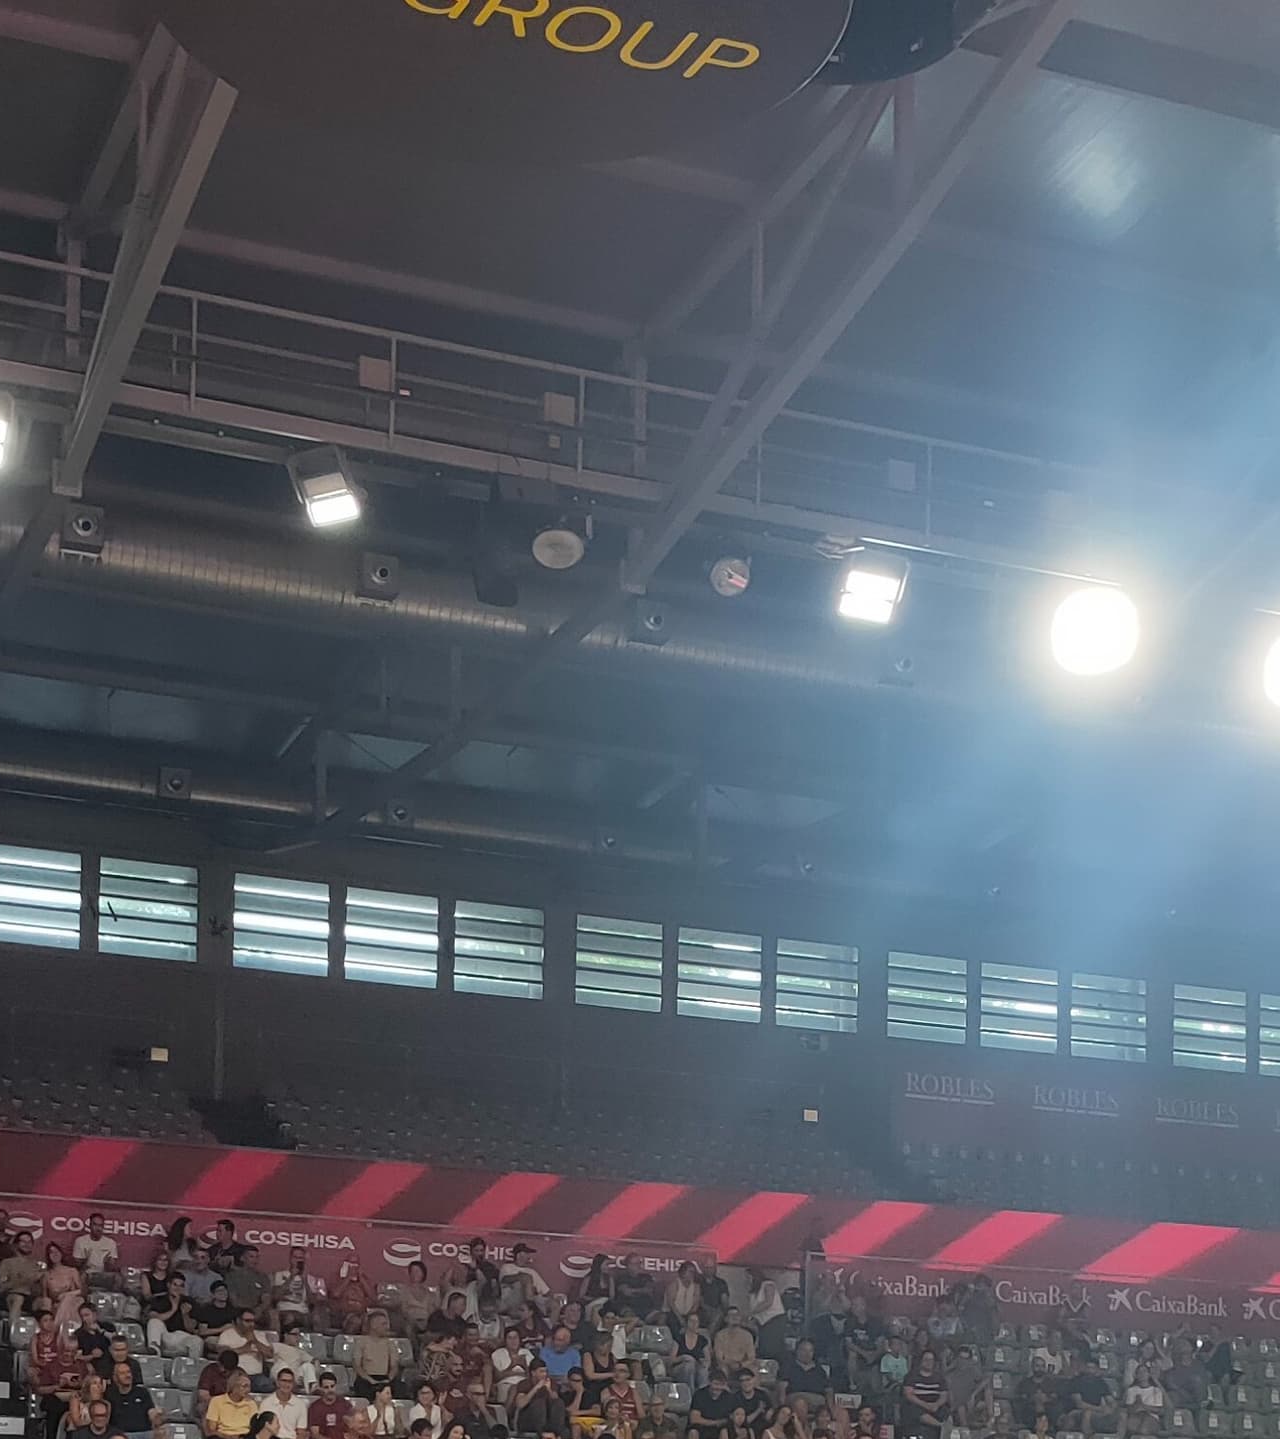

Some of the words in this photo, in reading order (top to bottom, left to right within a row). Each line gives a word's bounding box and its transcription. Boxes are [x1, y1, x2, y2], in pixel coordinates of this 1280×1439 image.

[906, 1071, 995, 1101] ROBLES
[245, 1229, 355, 1251] COSEHISA
[1136, 1291, 1228, 1319] CaixaBank
